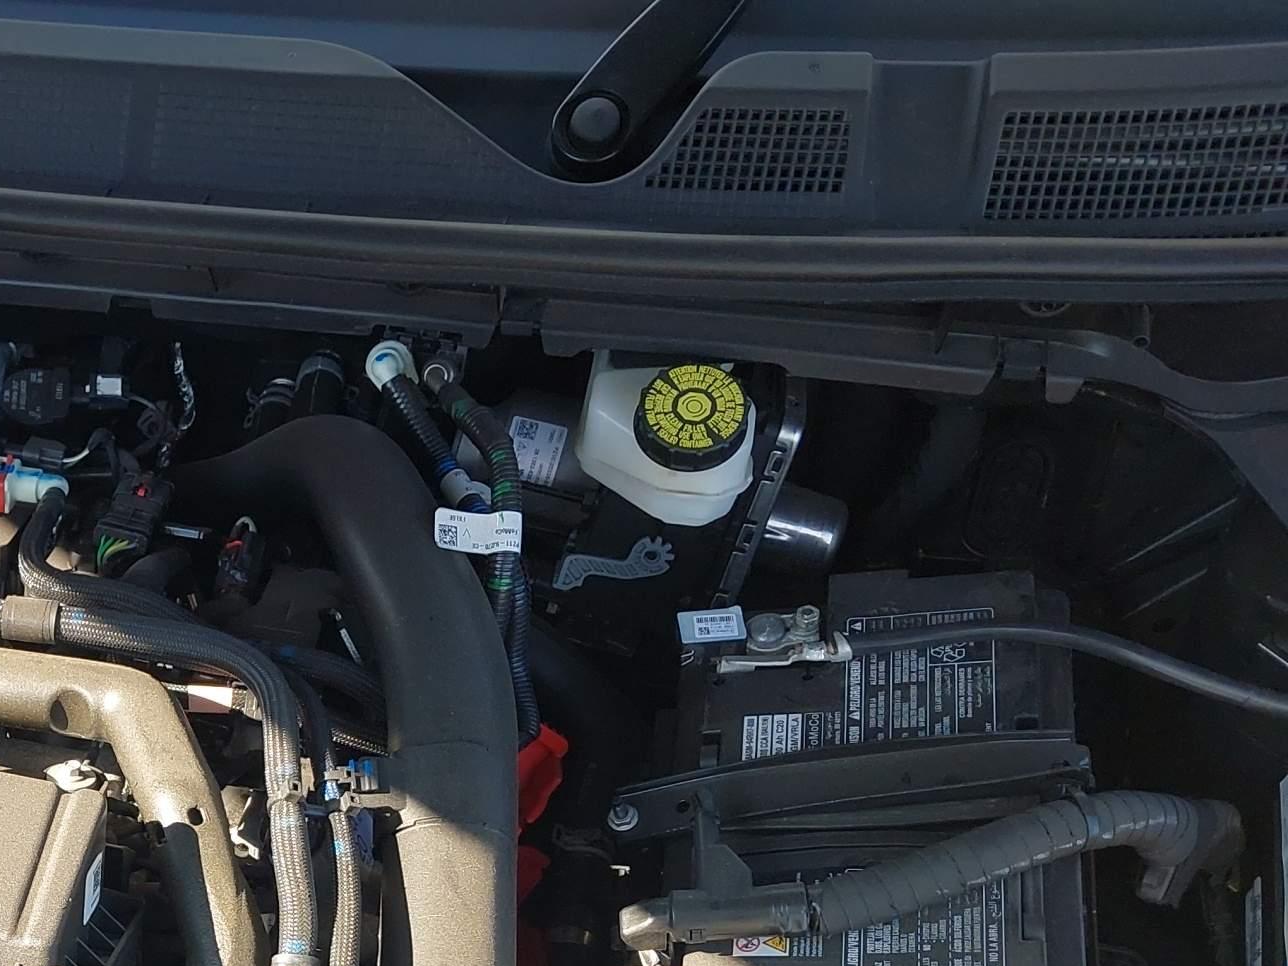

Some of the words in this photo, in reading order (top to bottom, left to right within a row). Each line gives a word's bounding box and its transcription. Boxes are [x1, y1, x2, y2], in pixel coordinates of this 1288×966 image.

[657, 428, 679, 444] SEALED
[678, 438, 714, 449] CONTAINER
[678, 431, 690, 439] USE
[849, 661, 861, 710] PELIGRO/VENENO
[776, 719, 785, 734] C20
[790, 717, 800, 751] GM/VRLA
[776, 735, 785, 745] Ah
[849, 726, 861, 743] ISON
[760, 737, 769, 749] CCA
[989, 921, 999, 942] ABRA.
[989, 942, 999, 951] LA
[989, 952, 999, 962] NO
